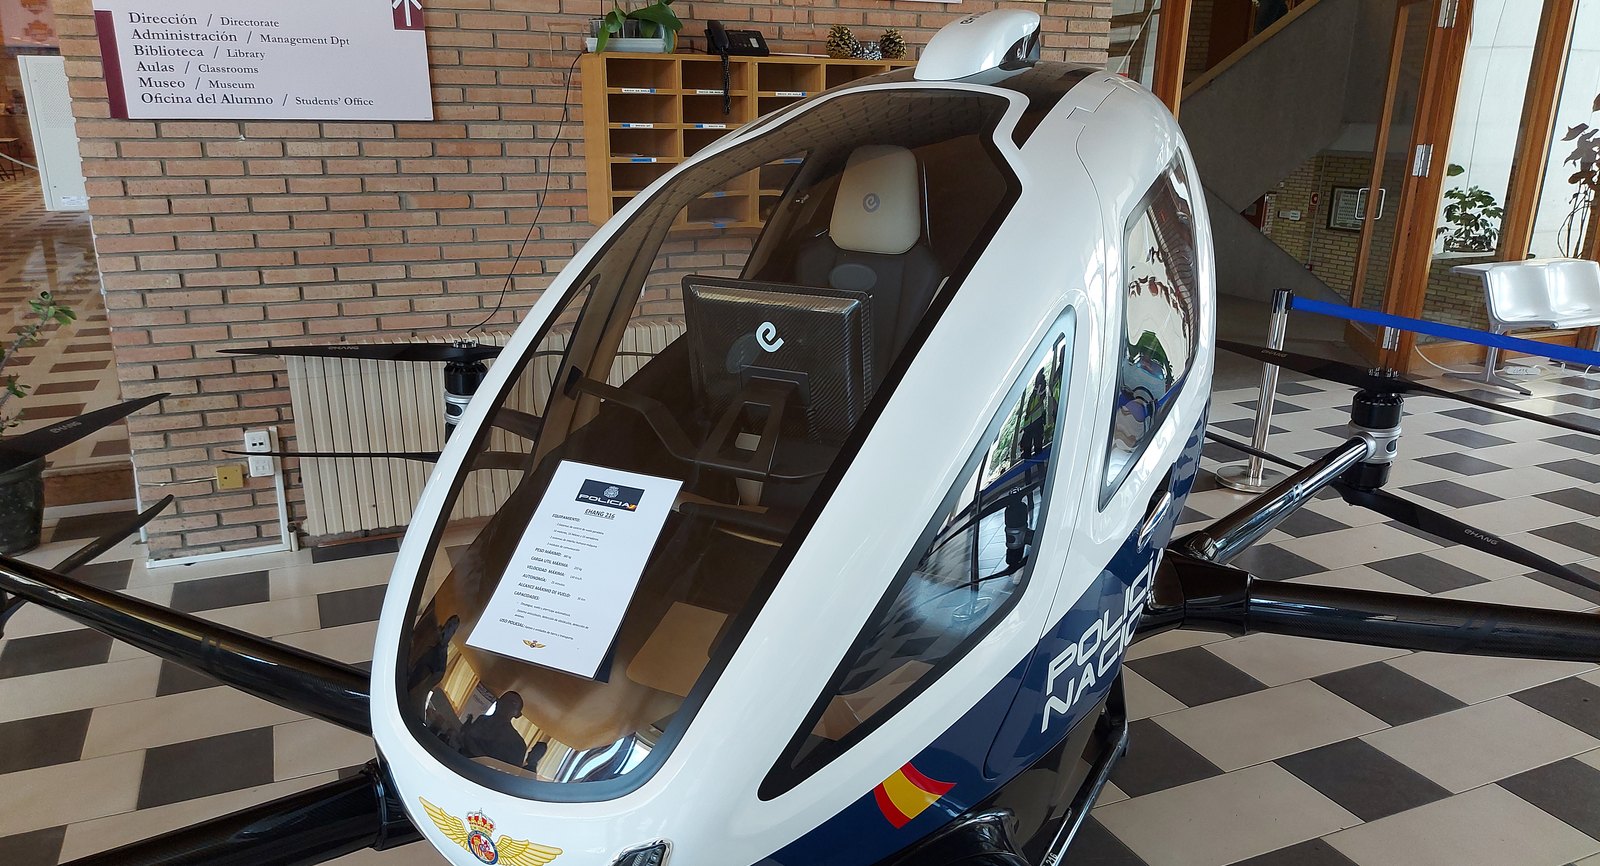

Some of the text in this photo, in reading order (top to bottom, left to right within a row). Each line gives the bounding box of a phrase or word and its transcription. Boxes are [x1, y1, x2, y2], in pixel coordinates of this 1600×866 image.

[128, 12, 198, 25] Dirección
[220, 17, 280, 28] Directorate
[131, 29, 238, 42] Administración
[259, 34, 328, 47] Management
[330, 36, 350, 48] Dpt
[132, 45, 205, 57] Biblioteca
[226, 49, 266, 61] Library
[136, 61, 175, 73] Aulas
[198, 64, 259, 74] Classrooms
[137, 77, 186, 89] Museo
[208, 80, 255, 89] Museum
[140, 93, 193, 104] Oficina
[196, 94, 217, 104] del
[220, 94, 274, 105] Alumno
[295, 97, 341, 106] Students’
[343, 97, 374, 106] Office
[579, 494, 630, 509] POLICIA
[584, 508, 616, 520] EHANG 216
